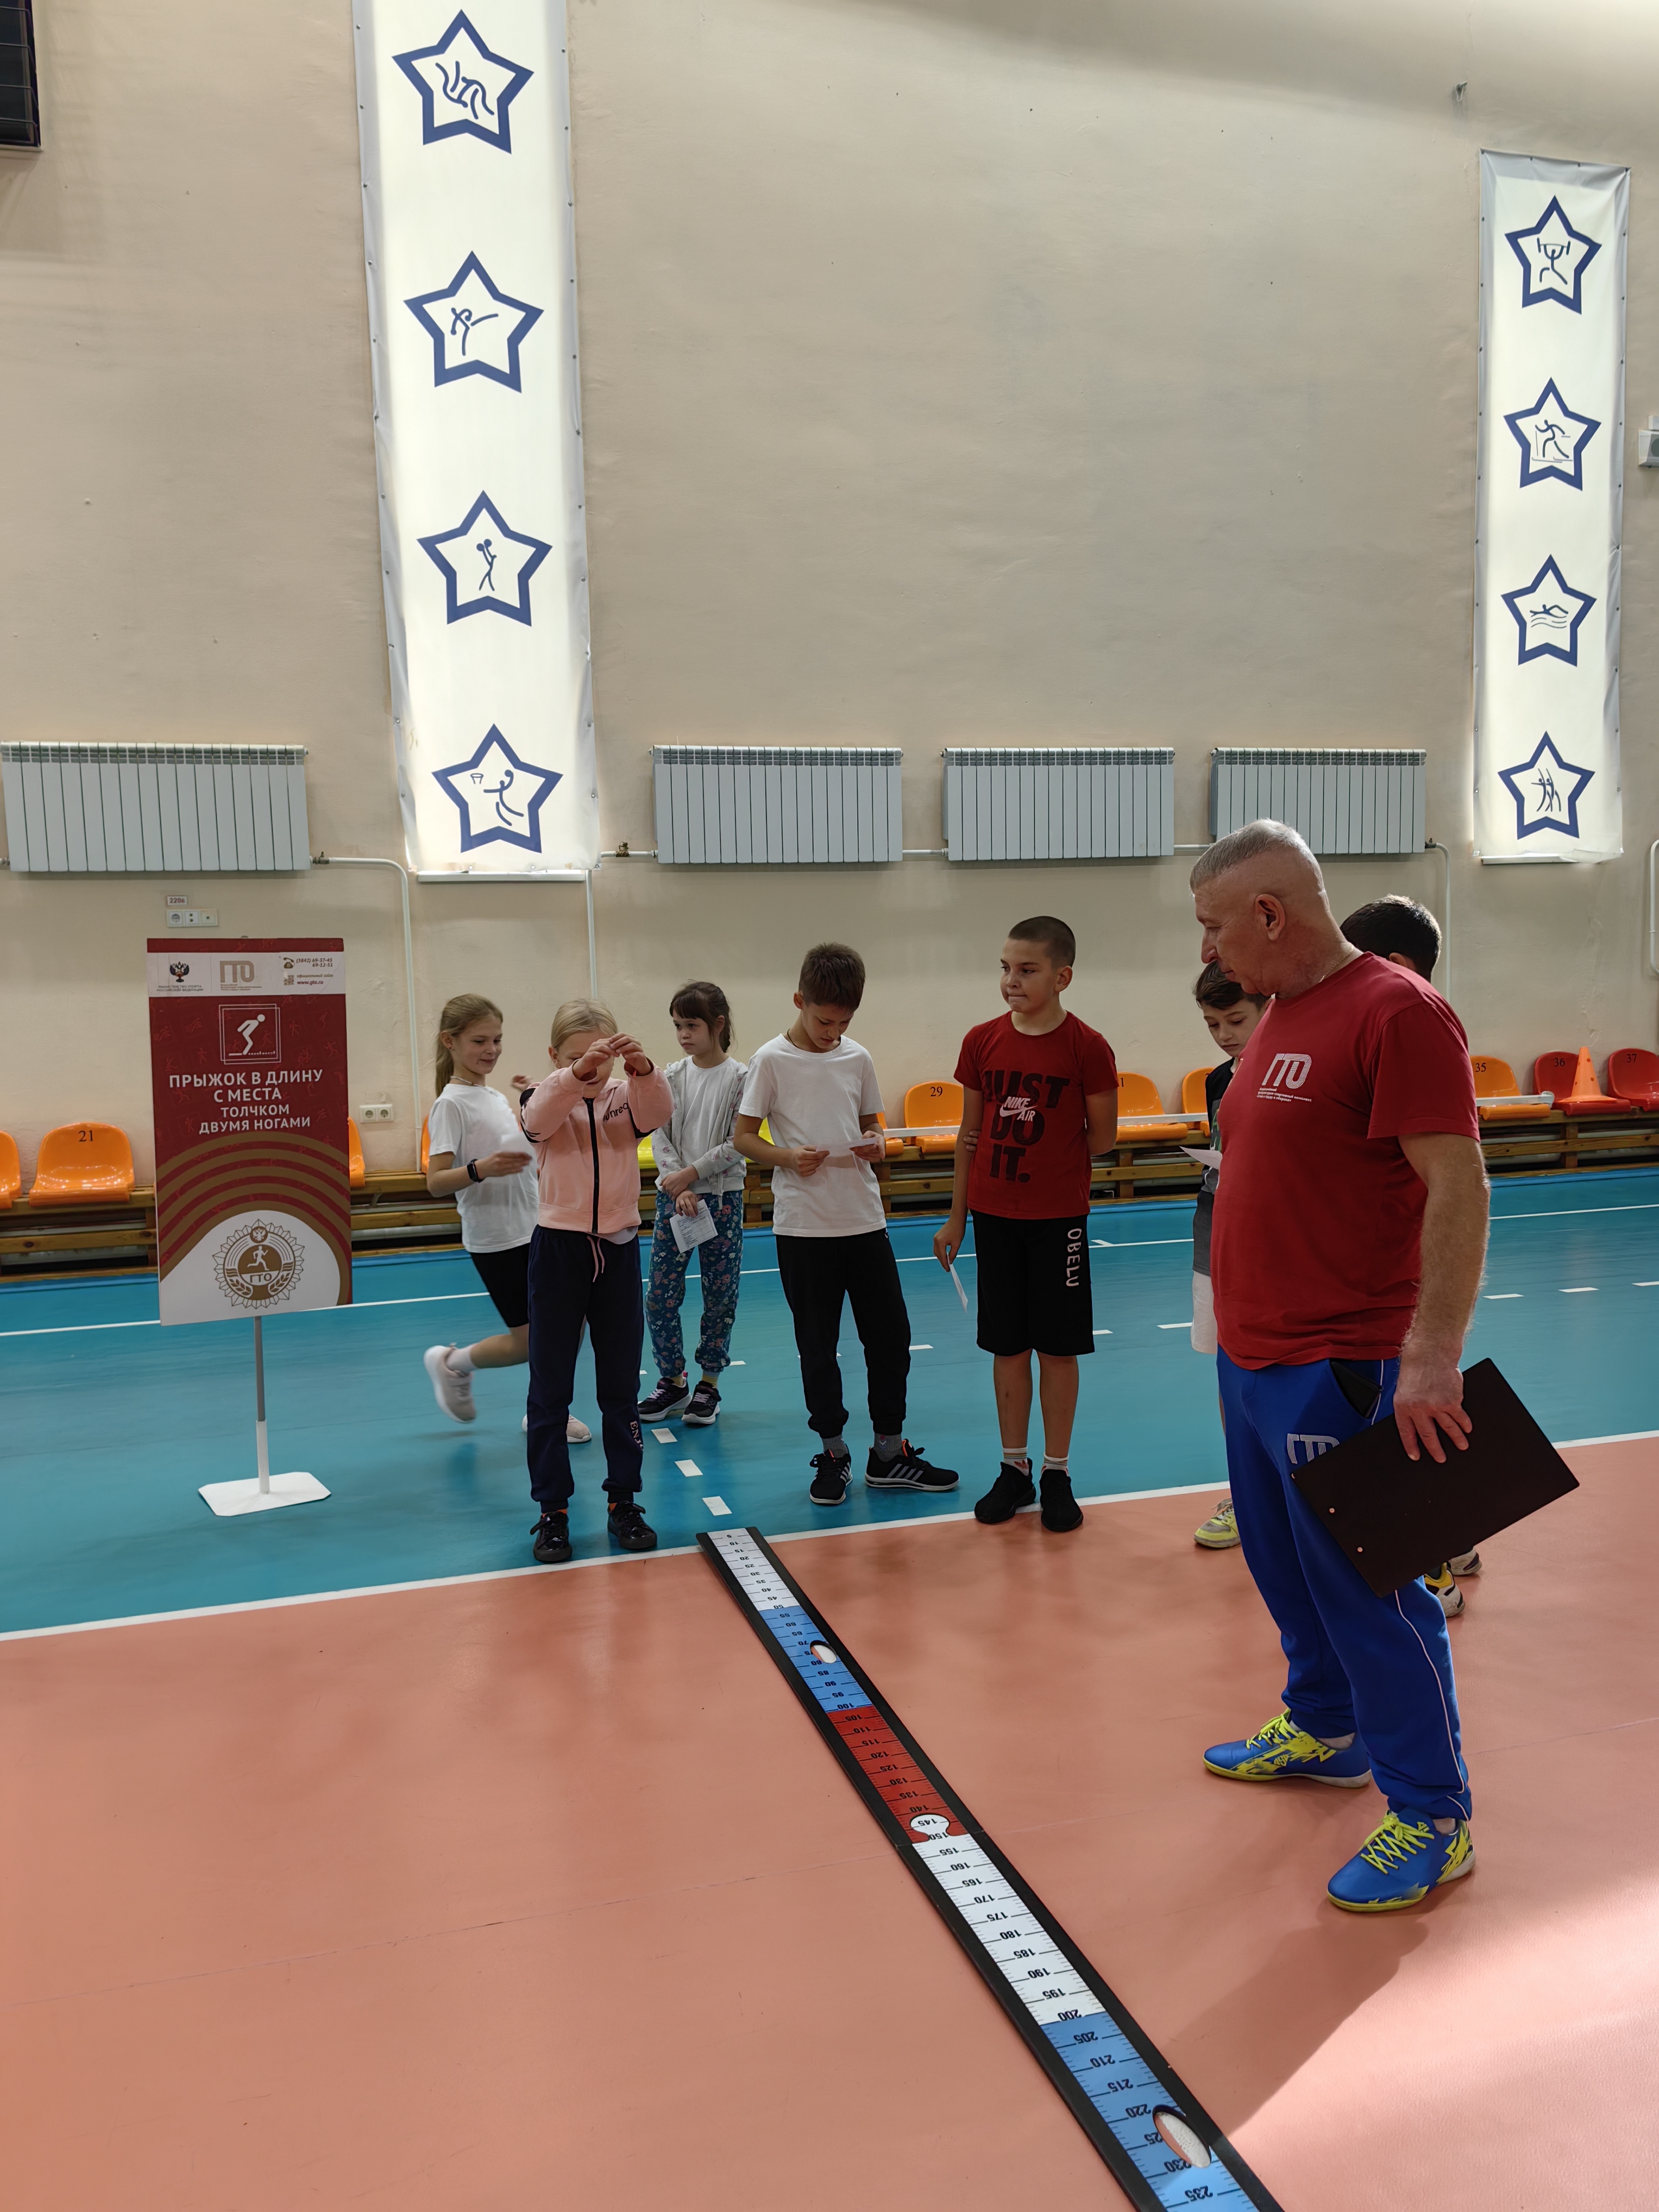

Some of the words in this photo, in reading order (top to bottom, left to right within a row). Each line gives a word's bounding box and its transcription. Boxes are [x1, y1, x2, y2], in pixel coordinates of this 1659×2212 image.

[220, 961, 254, 983] ГТО
[1554, 1057, 1566, 1067] 36
[1626, 1053, 1637, 1063] 37
[1261, 1053, 1312, 1089] ГТО
[1475, 1062, 1486, 1072] 35
[169, 1073, 247, 1088] ПРЫЖОК
[252, 1072, 261, 1084] В
[265, 1069, 323, 1086] ДЛИНУ
[213, 1090, 223, 1103] С
[228, 1087, 282, 1102] МЕСТА
[930, 1086, 943, 1097] 29
[1003, 1096, 1031, 1109] NIKE
[221, 1104, 289, 1118] ТОЛЧКОМ
[1016, 1110, 1036, 1121] AIR
[199, 1120, 249, 1135] ДВУМЯ
[254, 1117, 310, 1130] НОГАМИ
[990, 1104, 1045, 1146] DO
[78, 1130, 94, 1142] 21
[989, 1143, 1031, 1183] IT.
[1066, 1228, 1082, 1286] OBELU
[250, 1273, 272, 1283] ГТО
[929, 1832, 948, 1840] 150
[939, 1848, 959, 1856] 155
[951, 1863, 971, 1871] 160
[962, 1878, 983, 1887] 165
[974, 1895, 995, 1904] 170
[987, 1912, 1008, 1921] 175
[1000, 1929, 1022, 1940] 180
[1013, 1948, 1036, 1959] 185
[1027, 1968, 1051, 1979] 190
[1042, 1989, 1066, 1999] 195
[1057, 2010, 1082, 2022] 200
[1073, 2031, 1098, 2044] 205
[1090, 2055, 1115, 2068] 210
[1107, 2079, 1133, 2093] 215
[1125, 2104, 1151, 2117] 220
[1164, 2158, 1192, 2172] 230
[1185, 2185, 1213, 2202] 235
